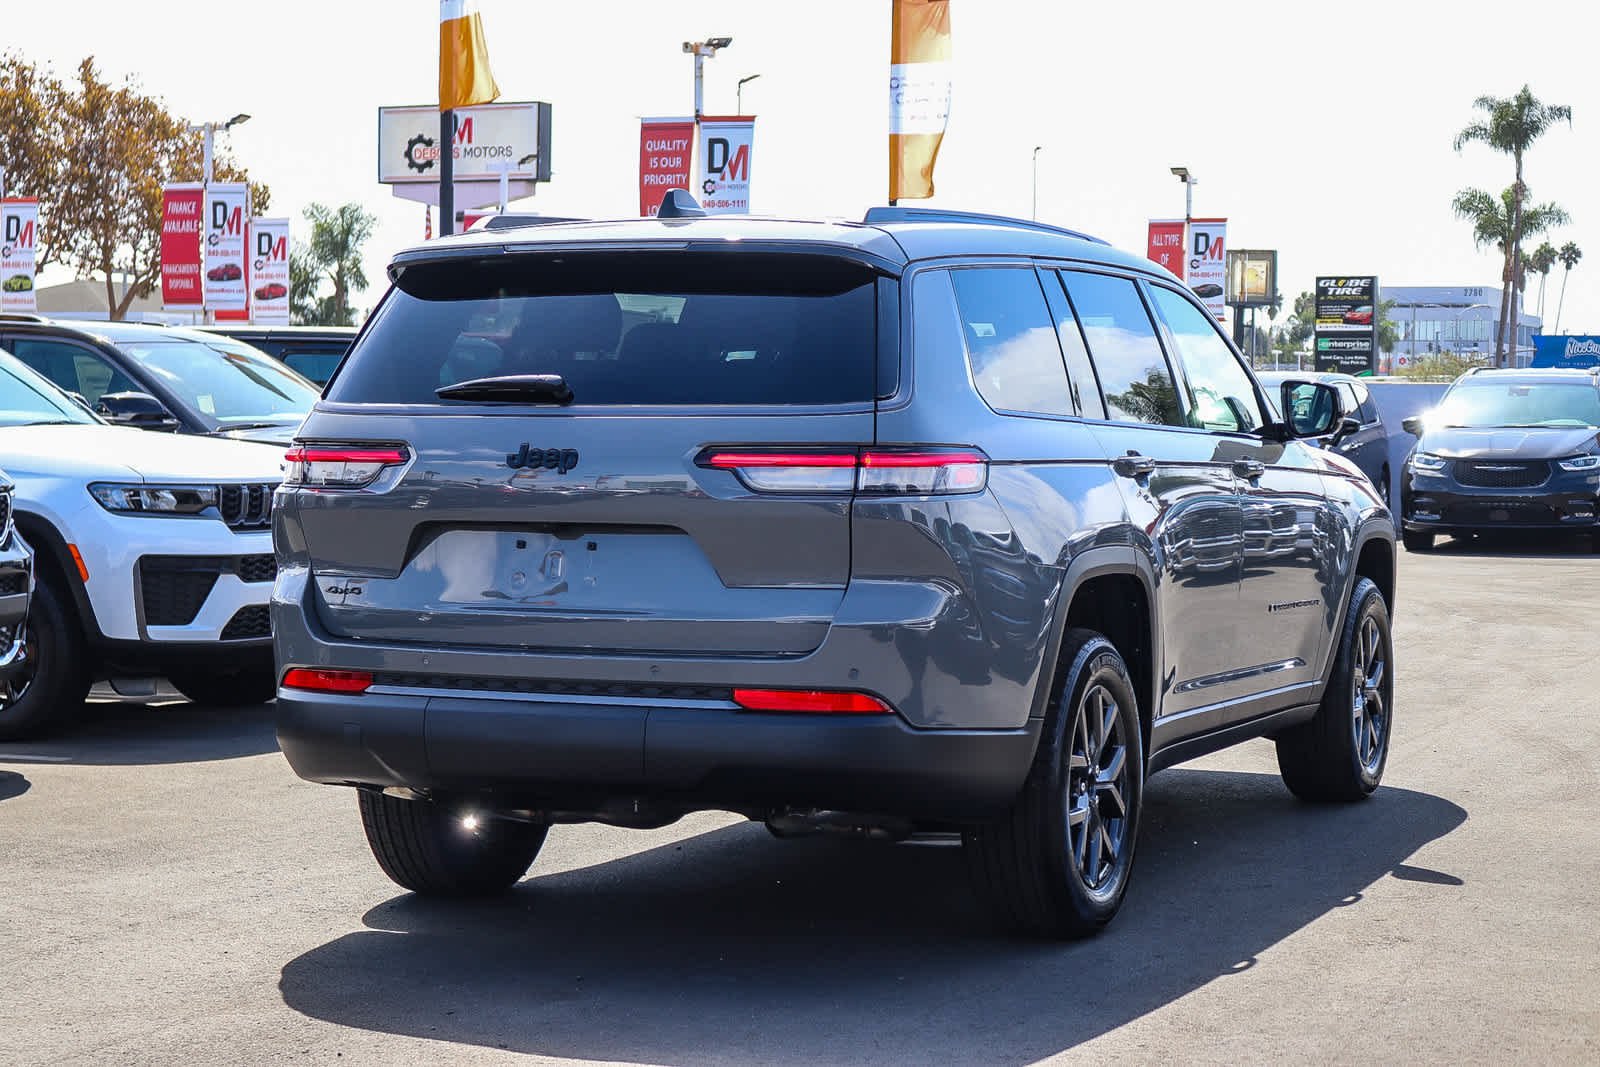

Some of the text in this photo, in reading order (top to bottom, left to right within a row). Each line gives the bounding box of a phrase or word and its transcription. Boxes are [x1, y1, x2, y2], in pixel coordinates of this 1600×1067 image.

[463, 145, 513, 159] MOTORS
[646, 139, 688, 152] QUALITY
[650, 156, 682, 168] IS OUR
[707, 137, 749, 181] DM
[644, 174, 687, 186] PRIORITY
[168, 201, 196, 215] FINANCE
[212, 200, 242, 236] DM
[6, 215, 34, 248] DM
[163, 220, 198, 233] AVAILABLE
[257, 231, 287, 261] DM
[1152, 234, 1180, 246] ALL TYPE
[1194, 232, 1224, 260] DM
[1160, 253, 1170, 265] OF
[1319, 279, 1371, 288] GLOBE
[1327, 287, 1363, 295] TIRE
[506, 442, 579, 475] Jeep
